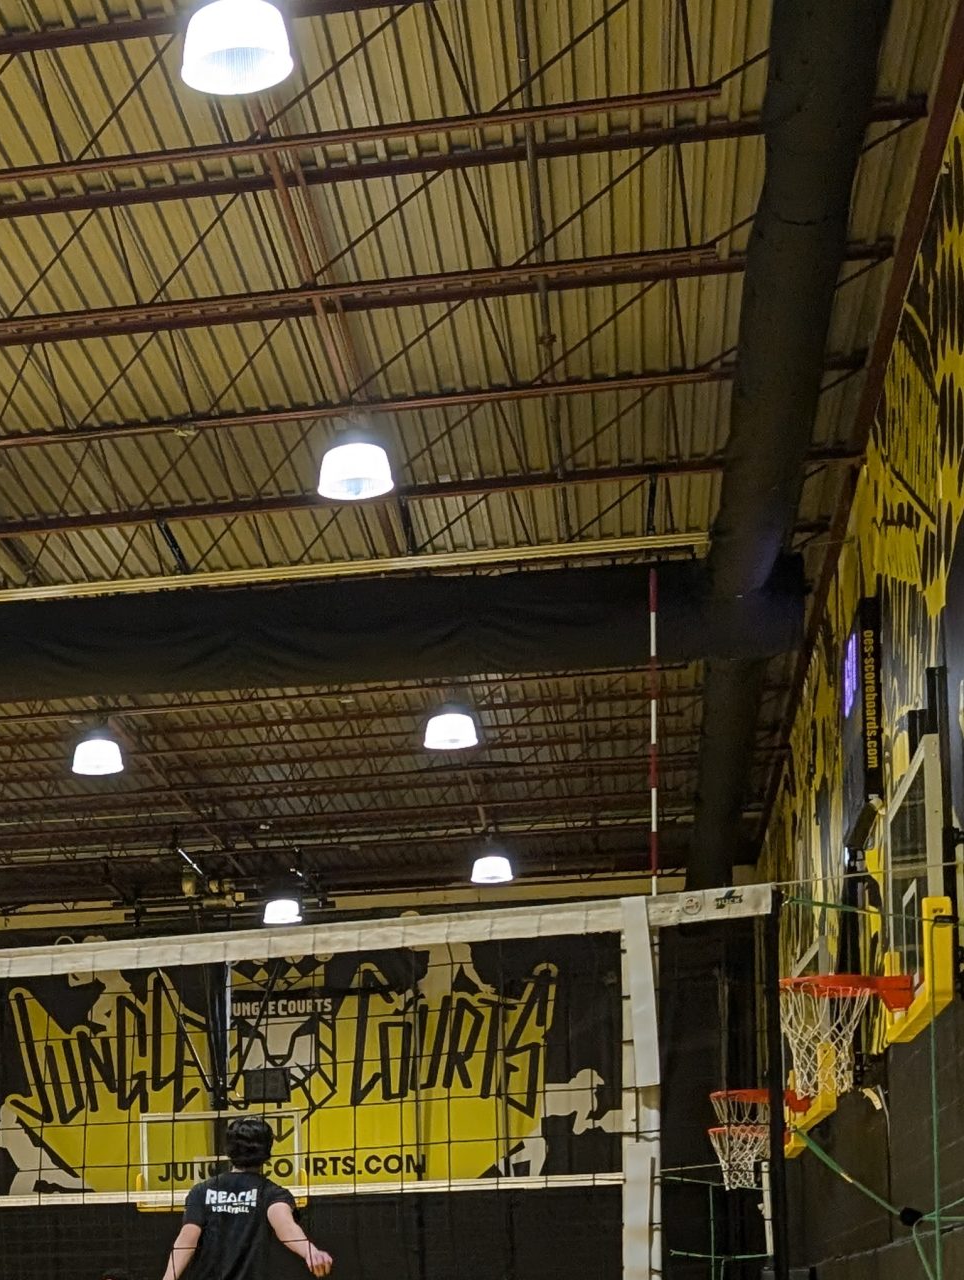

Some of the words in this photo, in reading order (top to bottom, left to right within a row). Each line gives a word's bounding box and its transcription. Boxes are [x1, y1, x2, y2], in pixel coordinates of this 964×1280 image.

[863, 629, 879, 769] oes-scoreboards.com
[8, 970, 210, 1124] JUNGLE
[350, 966, 550, 1120] COURTS
[205, 1188, 258, 1207] REACH
